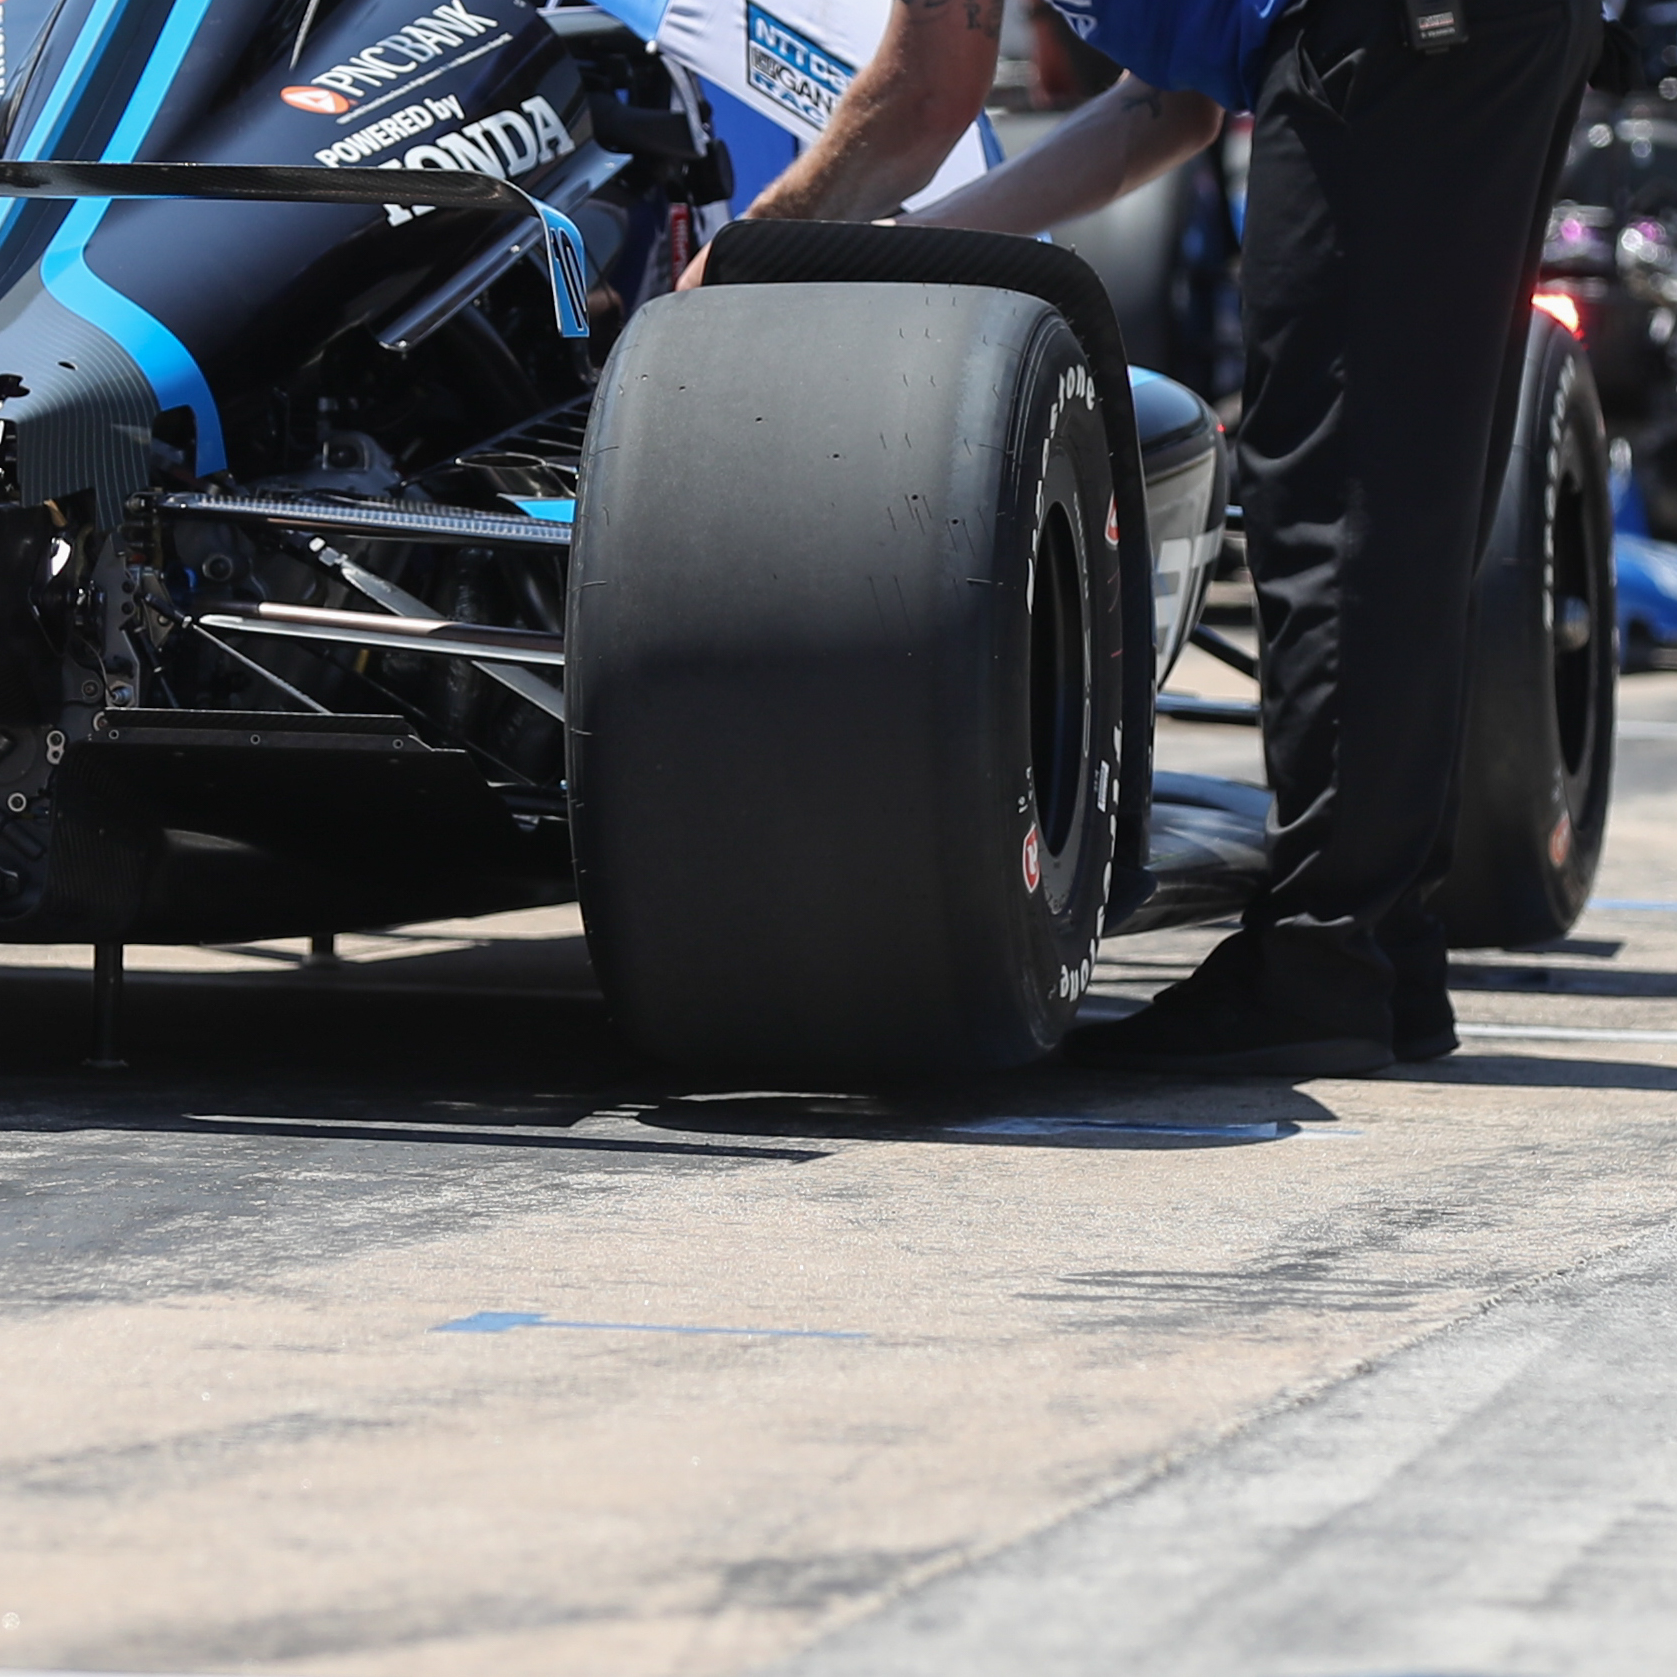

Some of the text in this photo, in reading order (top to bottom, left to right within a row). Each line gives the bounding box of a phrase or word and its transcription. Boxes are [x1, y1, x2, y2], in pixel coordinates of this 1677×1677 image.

[754, 16, 810, 67] NTT
[314, 105, 436, 168] POWERED
[423, 93, 466, 120] by
